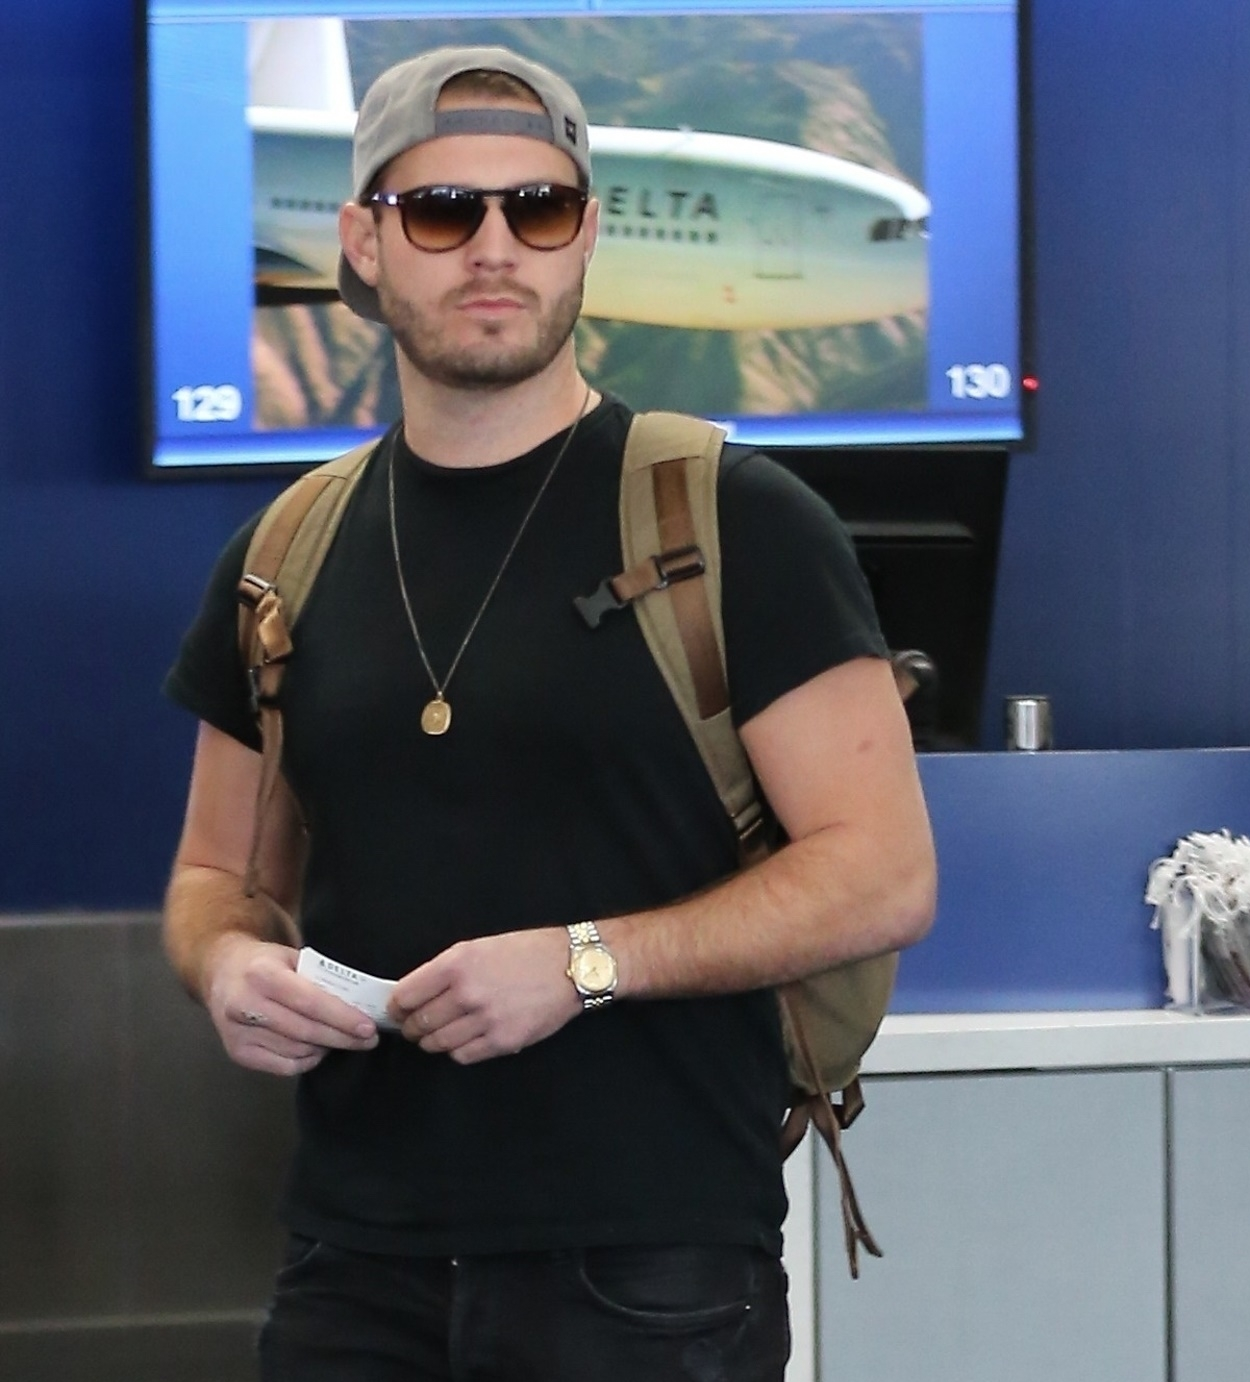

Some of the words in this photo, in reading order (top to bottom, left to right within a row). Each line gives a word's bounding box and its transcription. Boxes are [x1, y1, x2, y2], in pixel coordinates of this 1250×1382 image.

[604, 186, 719, 221] ELTA
[944, 362, 1012, 399] 130
[170, 383, 243, 421] 129
